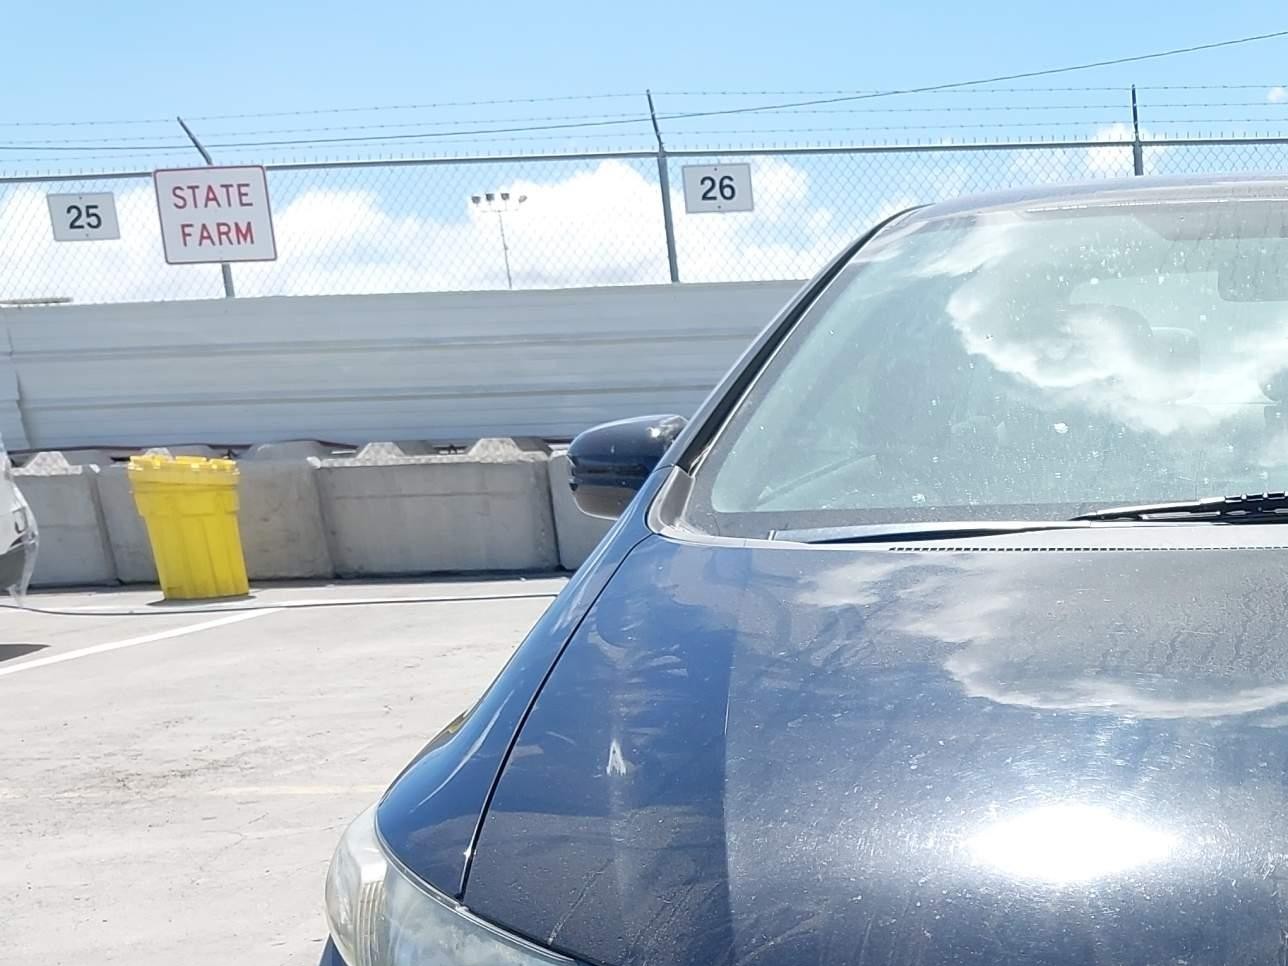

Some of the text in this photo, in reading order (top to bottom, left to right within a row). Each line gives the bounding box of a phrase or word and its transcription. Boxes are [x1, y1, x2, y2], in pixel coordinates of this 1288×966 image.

[172, 183, 254, 210] STATE
[700, 175, 736, 201] 26
[66, 205, 102, 230] 25
[180, 221, 255, 248] FARM
